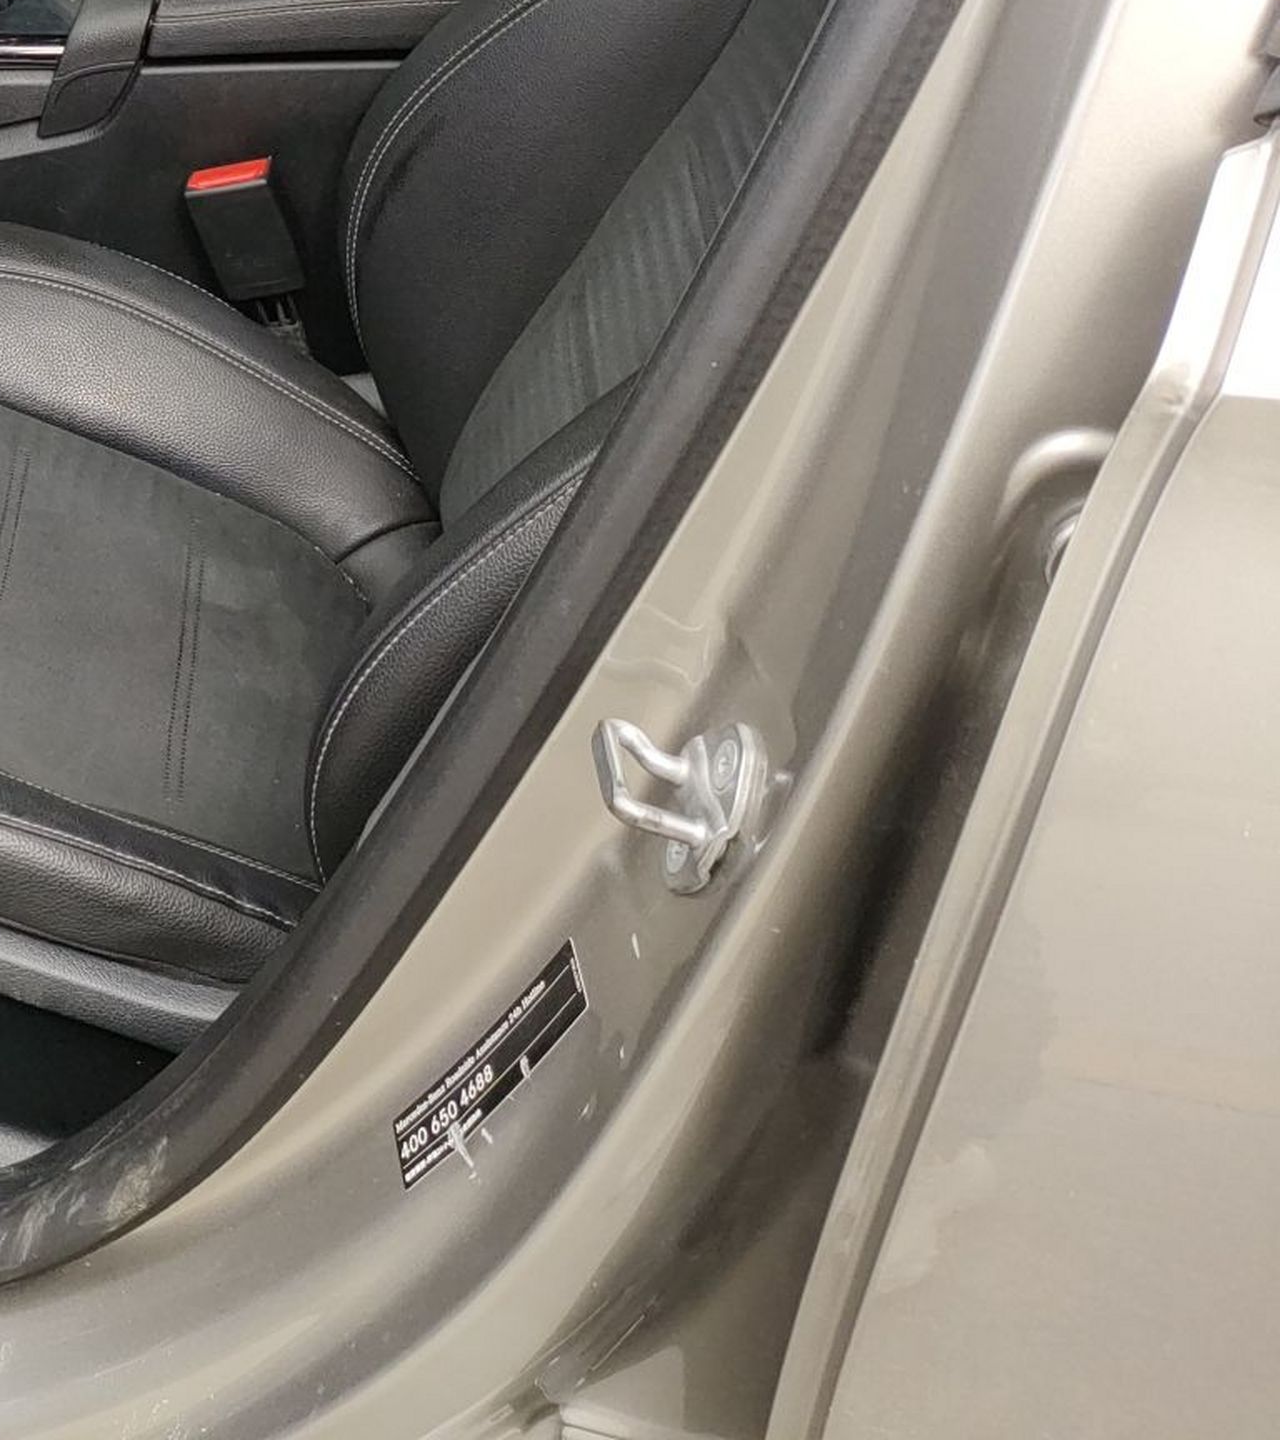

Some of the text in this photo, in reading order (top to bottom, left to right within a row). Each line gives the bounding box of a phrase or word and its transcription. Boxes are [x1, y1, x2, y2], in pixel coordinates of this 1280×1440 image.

[401, 1126, 428, 1160] 400
[431, 1100, 458, 1135] 650
[460, 1064, 493, 1108] 4688
